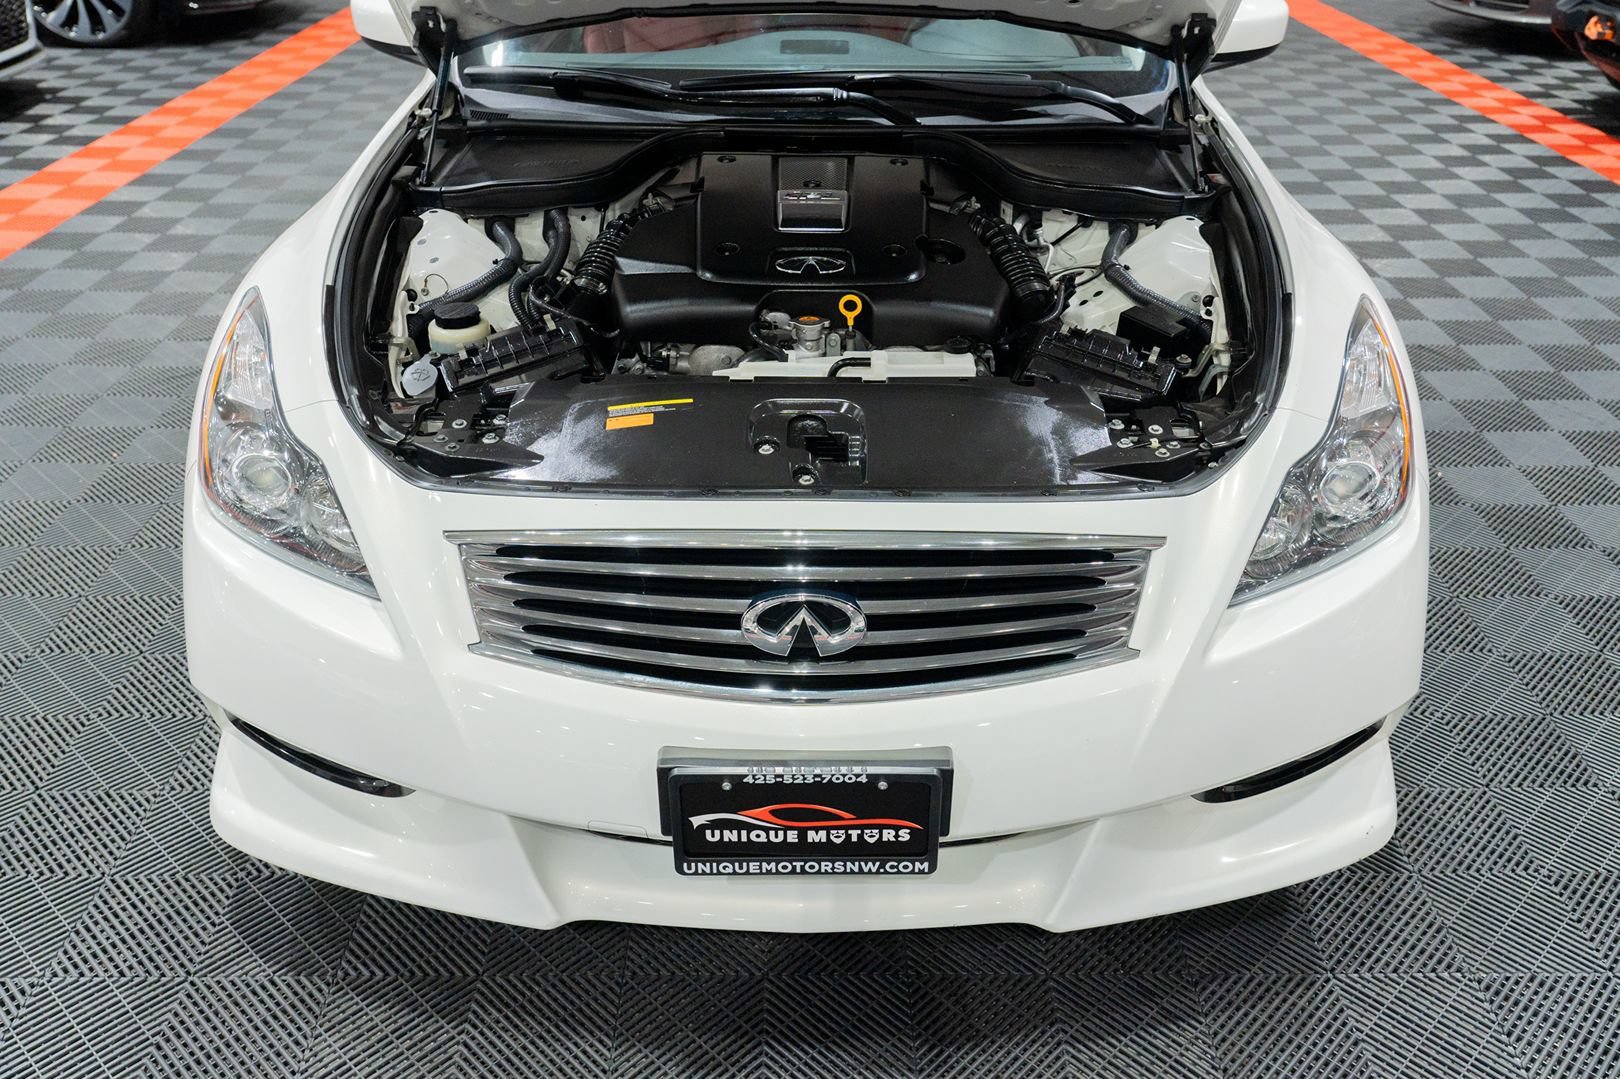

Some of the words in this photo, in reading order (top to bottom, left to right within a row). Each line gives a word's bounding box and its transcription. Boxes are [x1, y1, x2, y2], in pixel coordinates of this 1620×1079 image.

[743, 774, 868, 784] 425-523-7004
[705, 829, 798, 843] UNIQUE
[807, 829, 911, 844] MOTORS
[683, 862, 929, 875] UNIQUEMOTORSNW.COM
